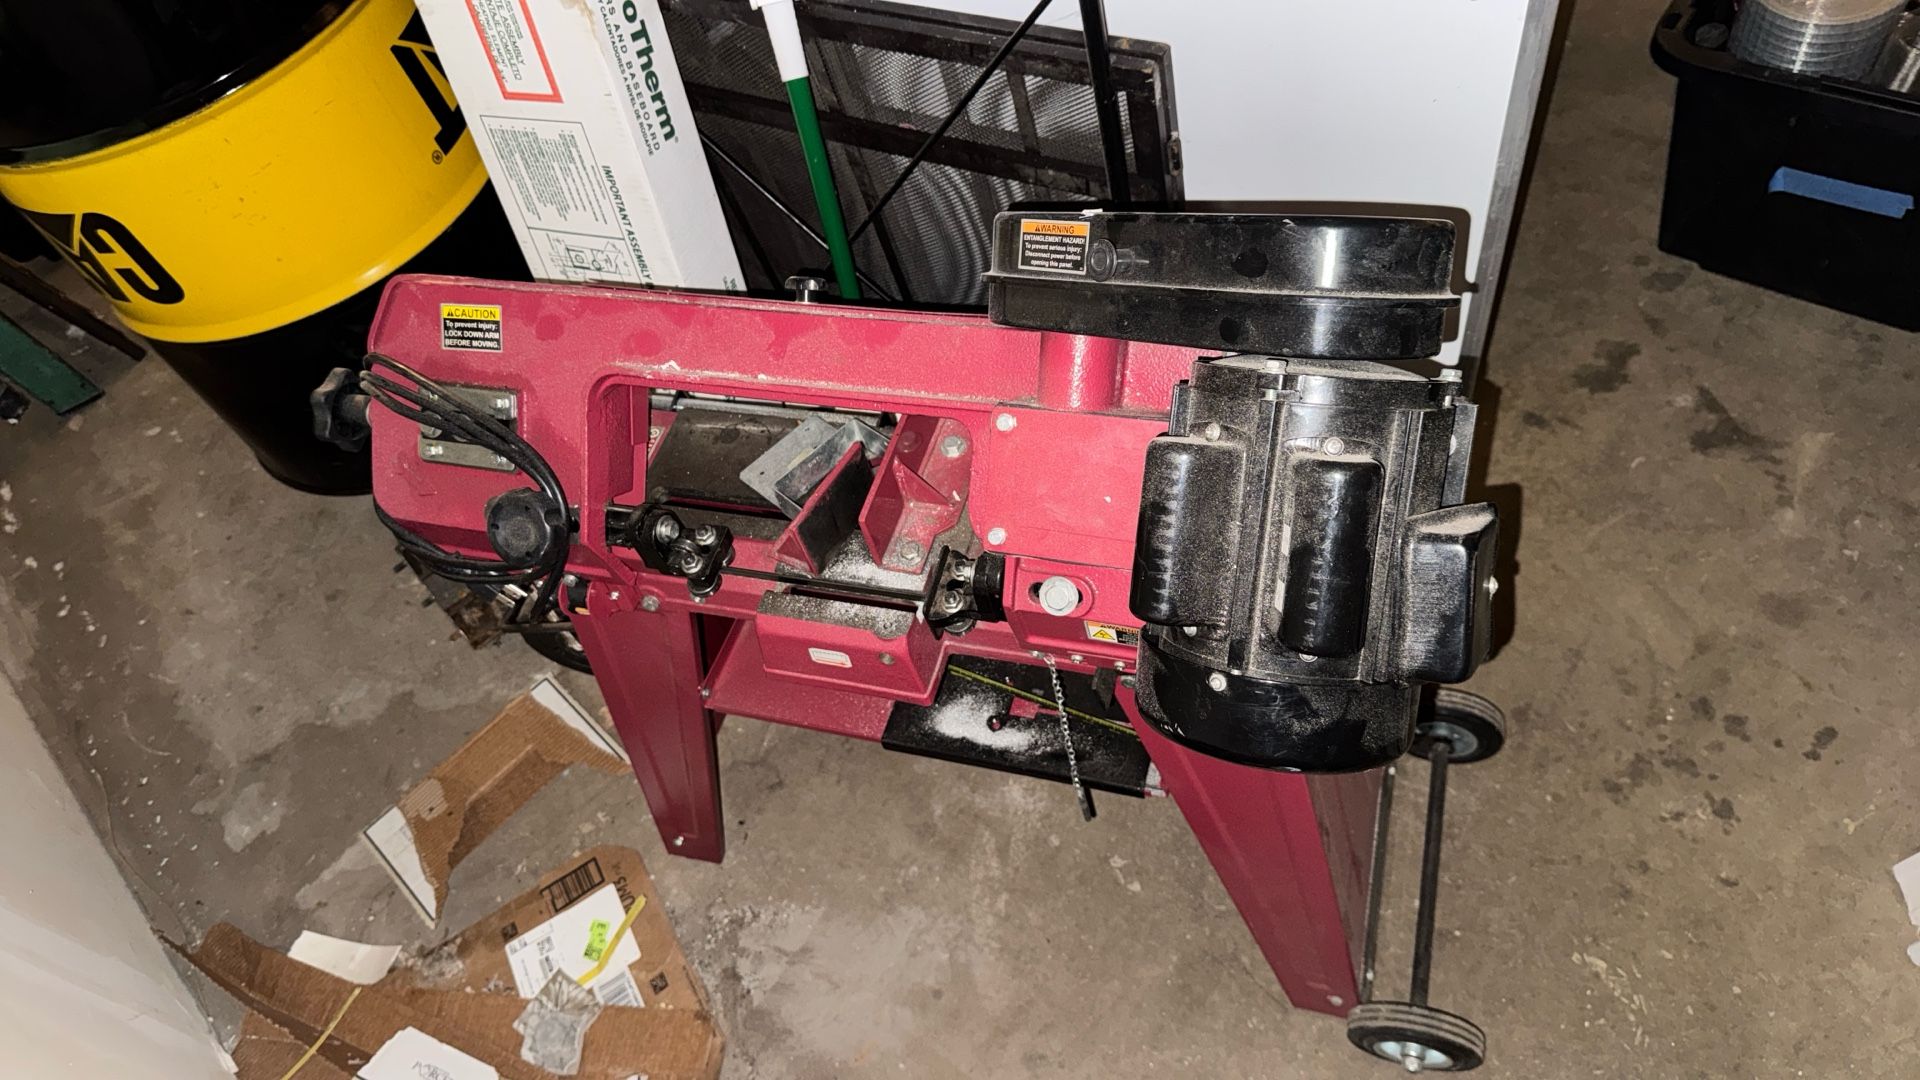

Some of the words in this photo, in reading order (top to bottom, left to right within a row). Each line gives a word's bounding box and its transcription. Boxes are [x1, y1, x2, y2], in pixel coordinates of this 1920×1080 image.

[500, 16, 526, 66] ASSEMBLY
[491, 33, 509, 69] ELEMENT
[498, 30, 522, 81] COMPLETO
[600, 6, 626, 75] CALENTADORES
[625, 83, 637, 109] NIVEL
[634, 109, 642, 121] DE
[638, 121, 654, 157] RODAPIE
[613, 23, 628, 54] AND
[625, 60, 661, 151] BASEBOARD
[601, 164, 632, 228] IMPORTANT
[625, 228, 653, 280] ASSEMBLY
[1040, 224, 1075, 235] WARNING
[1023, 234, 1062, 243] ENTANGLEMENT
[1062, 236, 1085, 245] HAZARD!
[1025, 250, 1050, 258] Disconnect
[1065, 253, 1081, 261] before
[1030, 260, 1049, 268] opening
[1058, 261, 1073, 269] panel.
[454, 308, 496, 319] CAUTION
[454, 321, 477, 330] prevent
[478, 322, 498, 331] injury:
[445, 339, 471, 347] BEFORE
[471, 340, 500, 349] MOVING.
